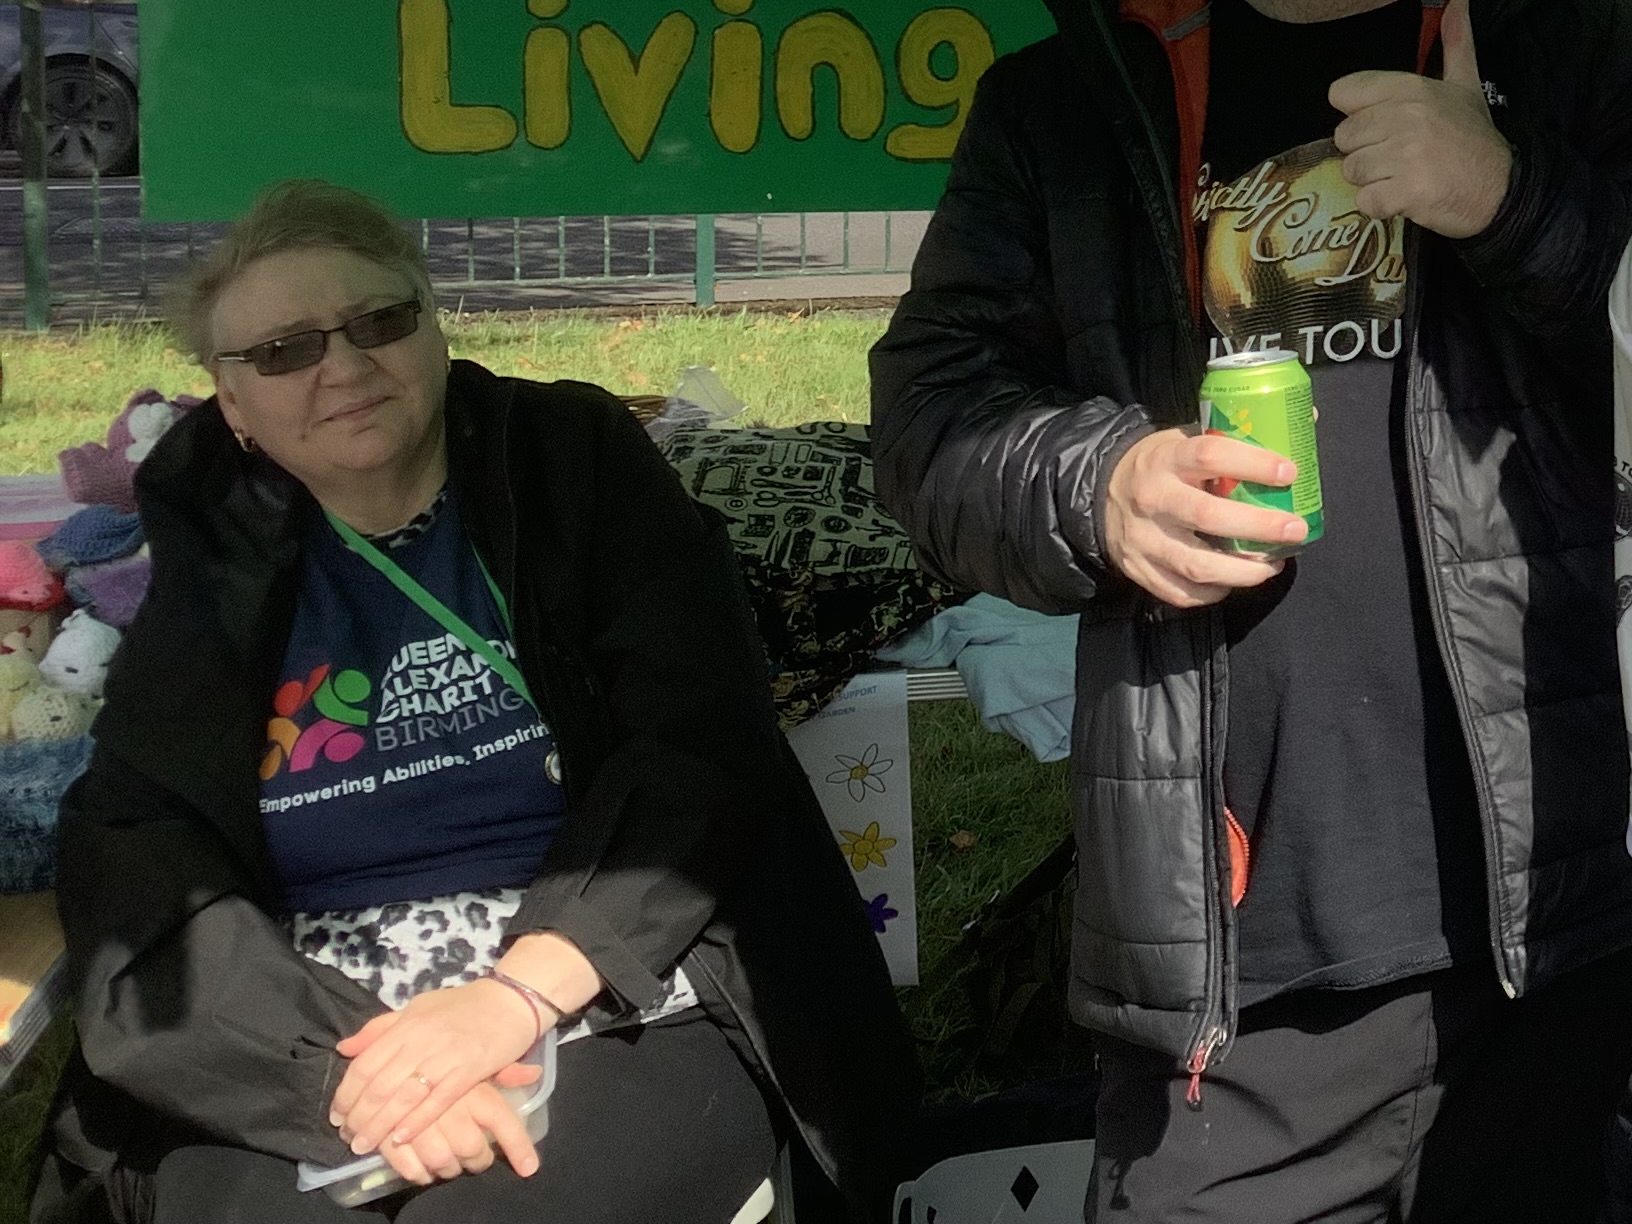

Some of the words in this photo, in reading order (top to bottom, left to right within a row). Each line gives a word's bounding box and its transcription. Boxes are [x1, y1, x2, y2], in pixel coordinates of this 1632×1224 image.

[1250, 192, 1359, 263] Come
[1298, 319, 1403, 365] TOU
[388, 633, 468, 675] UEEN
[375, 687, 525, 752] BIRMING
[376, 669, 493, 723] CHARIT
[260, 775, 376, 814] Empowering
[472, 723, 550, 761] Inspirin
